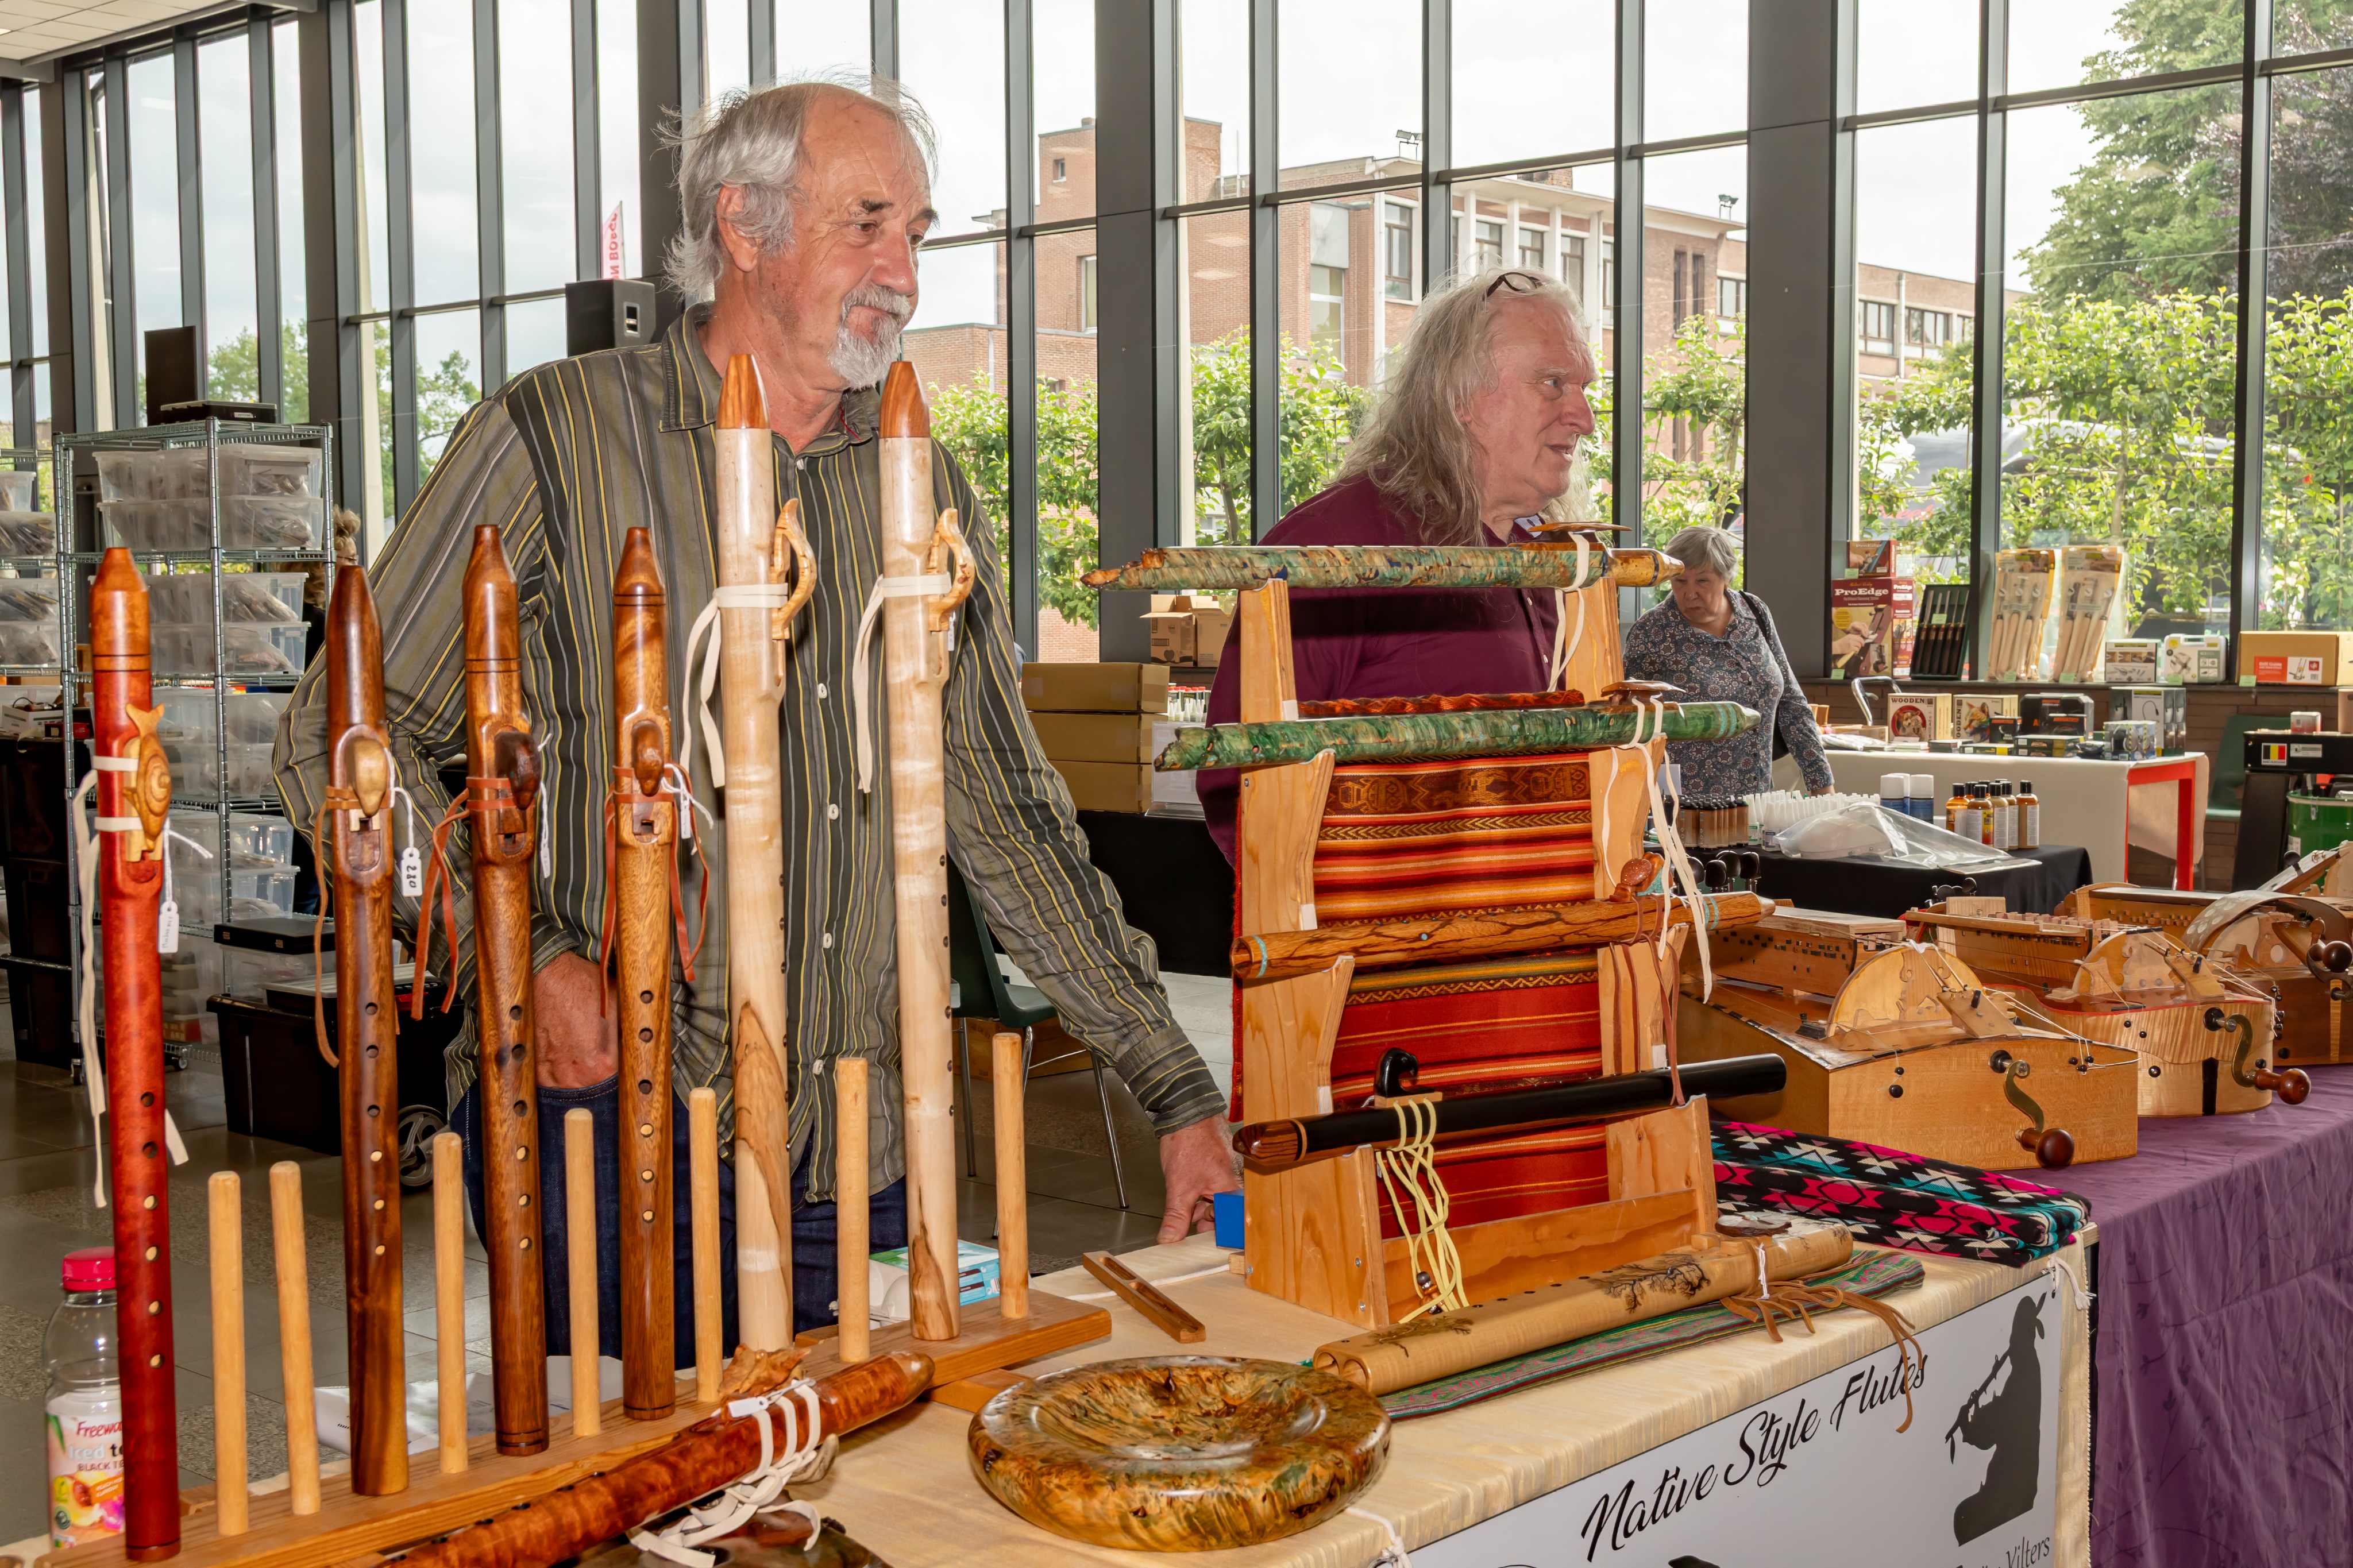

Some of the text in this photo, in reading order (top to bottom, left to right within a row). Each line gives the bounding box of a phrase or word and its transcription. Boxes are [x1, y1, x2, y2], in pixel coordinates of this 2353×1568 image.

[1834, 588, 1889, 597] ProEdge
[406, 865, 417, 888] 280
[76, 1420, 122, 1438] Freewa
[70, 1443, 105, 1459] Iced
[1581, 1354, 1928, 1563] Native Style Flutes
[77, 1461, 110, 1472] BLACK
[2005, 1536, 2050, 1568] Vilters
